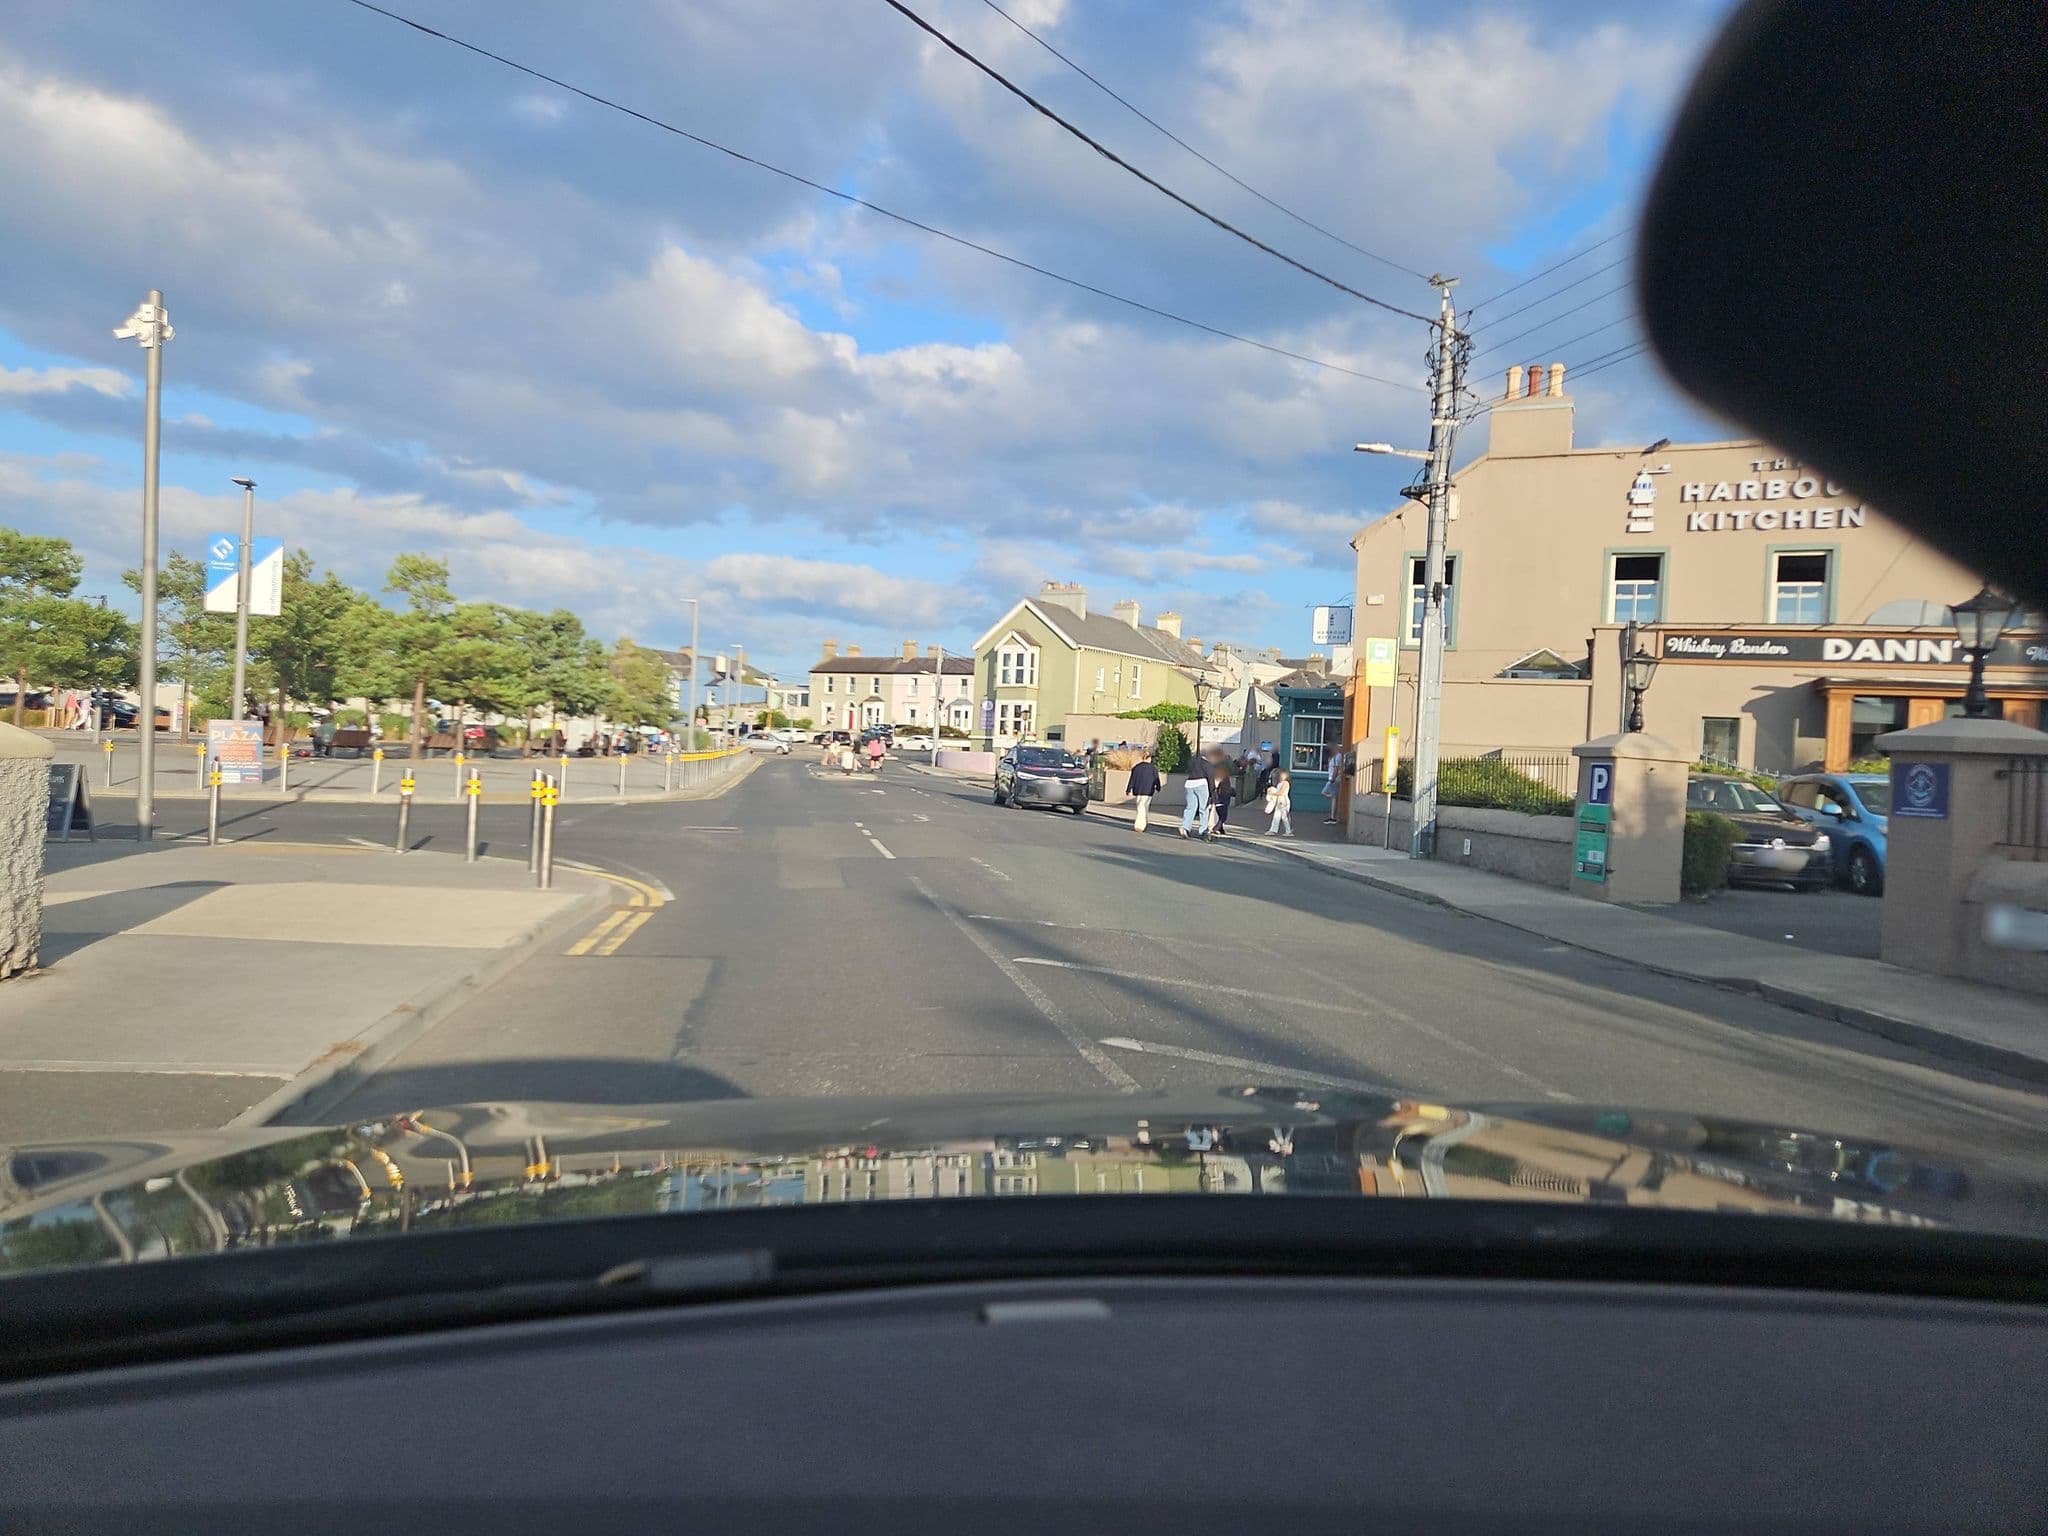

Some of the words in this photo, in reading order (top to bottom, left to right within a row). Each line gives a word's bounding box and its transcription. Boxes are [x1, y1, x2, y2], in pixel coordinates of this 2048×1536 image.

[1753, 457, 1803, 471] TH
[1689, 503, 1867, 531] KITCHEN
[1666, 636, 1727, 659] Whiskey
[211, 730, 263, 741] PLAZA
[1592, 767, 1608, 800] P
